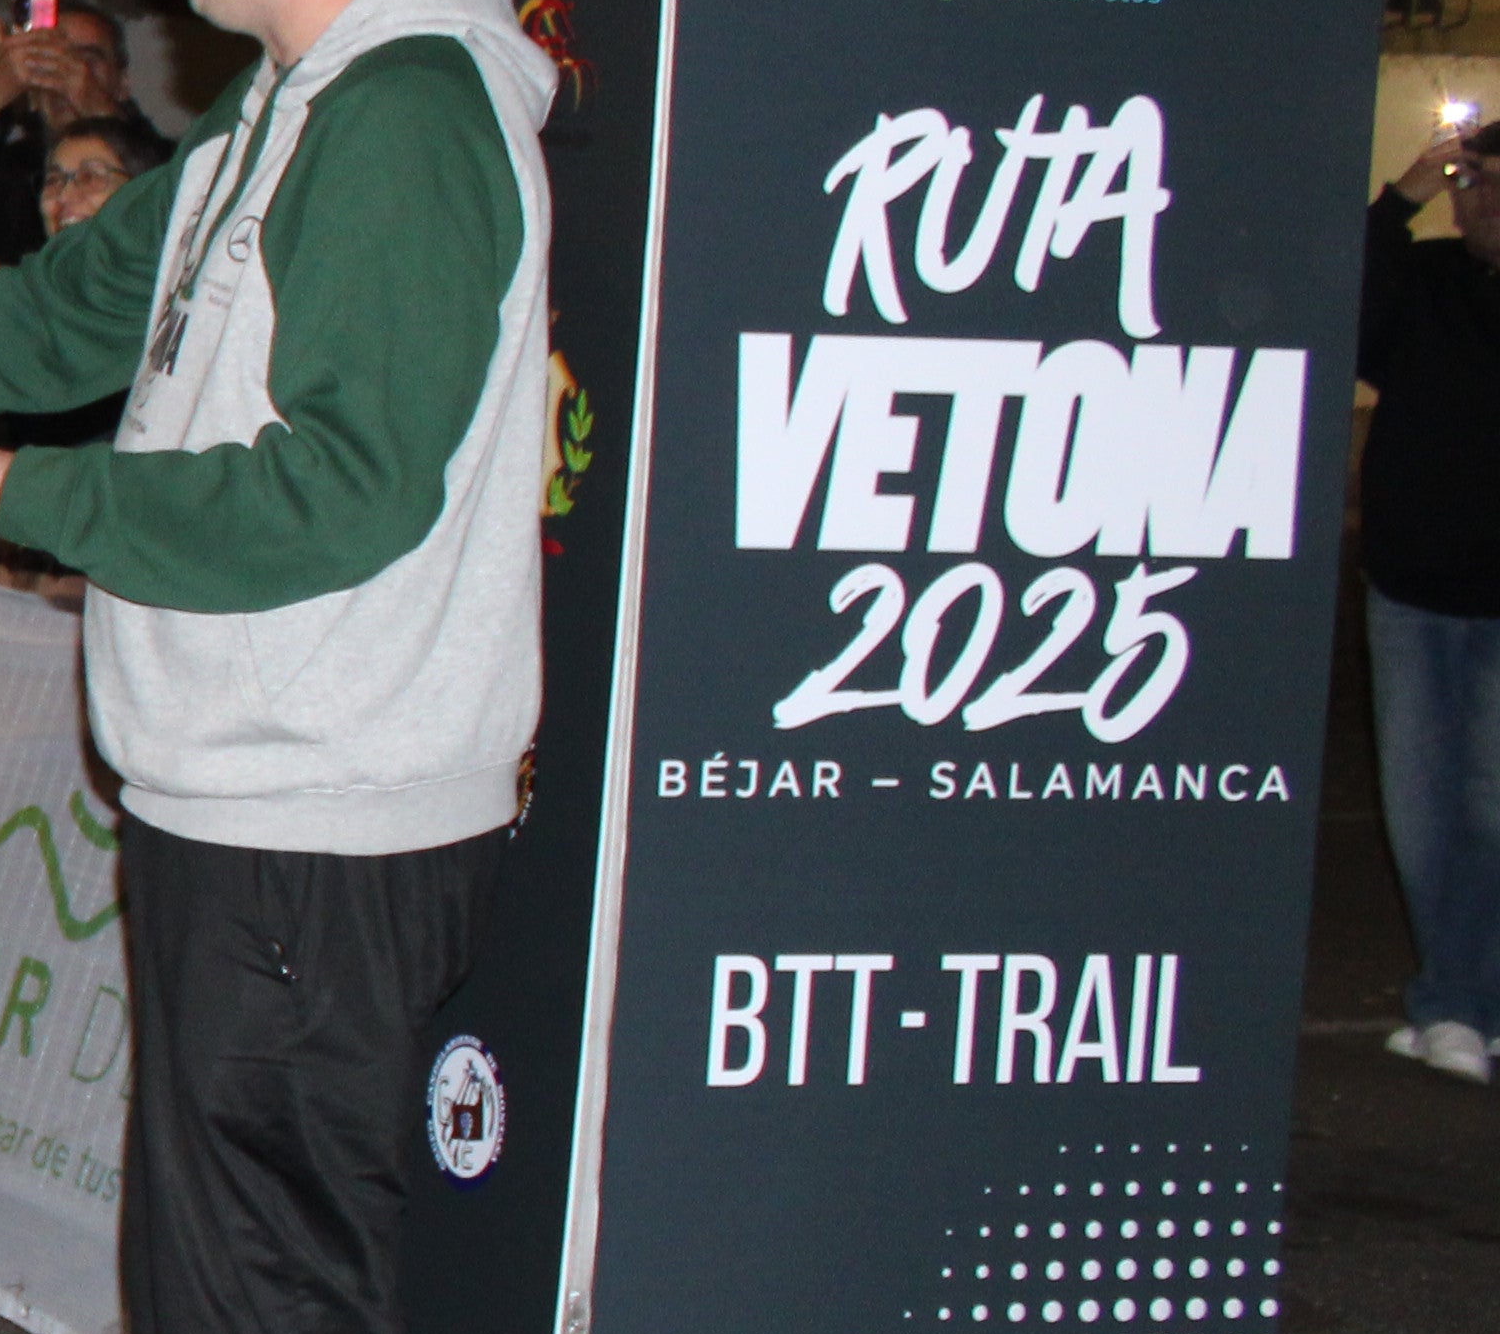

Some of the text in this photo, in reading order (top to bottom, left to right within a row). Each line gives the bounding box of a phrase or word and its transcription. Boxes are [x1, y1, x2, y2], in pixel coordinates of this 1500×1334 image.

[823, 93, 1170, 338] RUTA
[735, 332, 1307, 559] VETONA
[773, 563, 1198, 743] 2025
[657, 752, 842, 798] BÉJAR
[929, 762, 1290, 803] SALAMANCA
[707, 954, 1200, 1086] BTT-TRAIL
